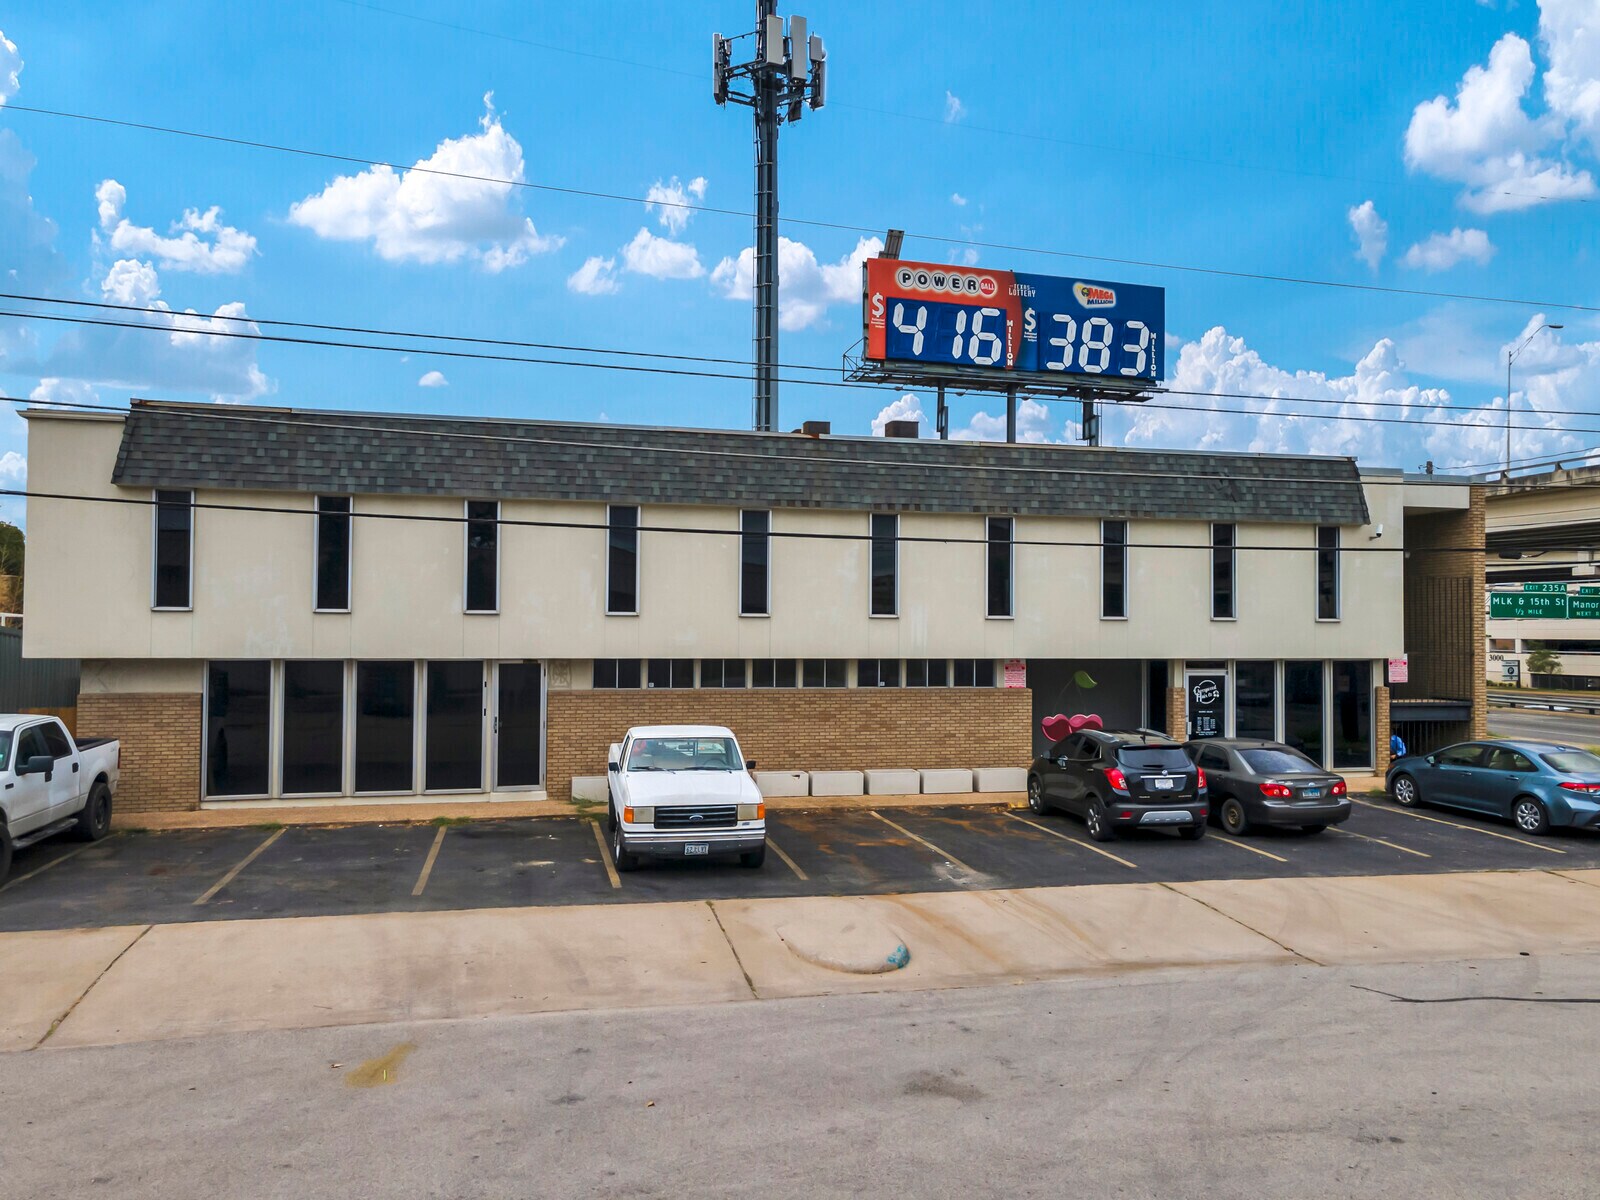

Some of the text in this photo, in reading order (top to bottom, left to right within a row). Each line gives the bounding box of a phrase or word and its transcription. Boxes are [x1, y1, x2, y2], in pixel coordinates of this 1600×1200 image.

[1008, 288, 1036, 298] LOTTERY
[1087, 287, 1114, 300] MEGA
[872, 292, 885, 318] $
[1006, 319, 1014, 366] MILLION
[1024, 307, 1150, 377] $ 383
[1542, 584, 1566, 592] 235A
[1492, 597, 1565, 606] MLK & 15th St
[1573, 600, 1599, 609] Manor
